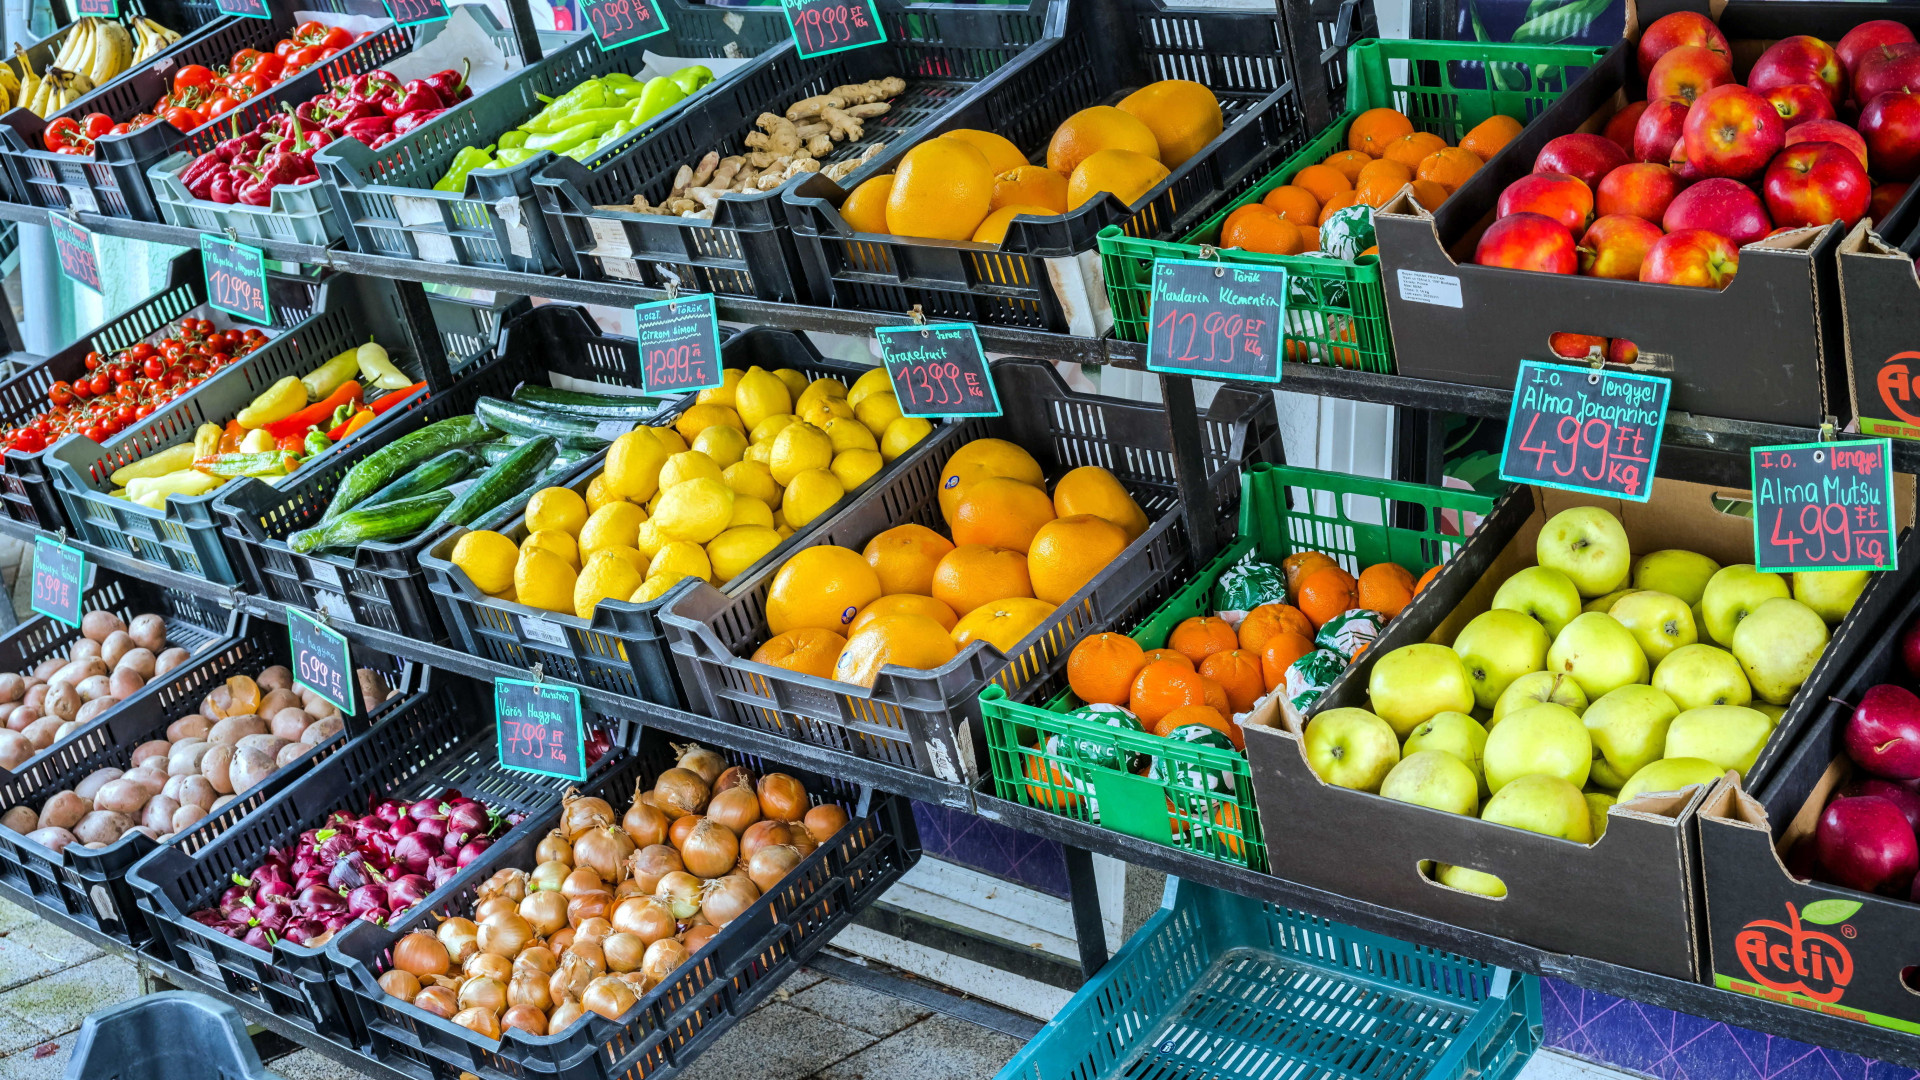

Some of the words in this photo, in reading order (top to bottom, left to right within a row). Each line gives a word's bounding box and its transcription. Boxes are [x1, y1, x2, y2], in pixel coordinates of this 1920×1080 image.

[592, 0, 634, 39] 299
[795, 5, 851, 51] 1999
[210, 270, 251, 311] 1299
[1155, 279, 1209, 303] Mandarin
[1219, 286, 1279, 307] Klementin
[1233, 269, 1260, 282] Török
[676, 304, 703, 314] TÖRÖK
[1245, 319, 1266, 332] FT
[1157, 309, 1243, 363] 1299
[884, 345, 947, 366] Grapefruit
[897, 362, 963, 405] 1399
[1522, 385, 1573, 415] Alma
[1576, 391, 1658, 430] Jonaprinc
[1519, 412, 1611, 481] 499
[1616, 426, 1645, 455] Ft
[1760, 477, 1818, 506] Alma
[1823, 475, 1881, 506] Mutsu
[1770, 503, 1851, 563] 499
[1854, 505, 1878, 528] Ft
[37, 572, 60, 605] 599
[300, 650, 328, 687] 699
[500, 697, 522, 717] Vörös
[527, 702, 562, 725] Hagyma
[504, 721, 546, 759] 799
[1735, 926, 1854, 988] Activ
